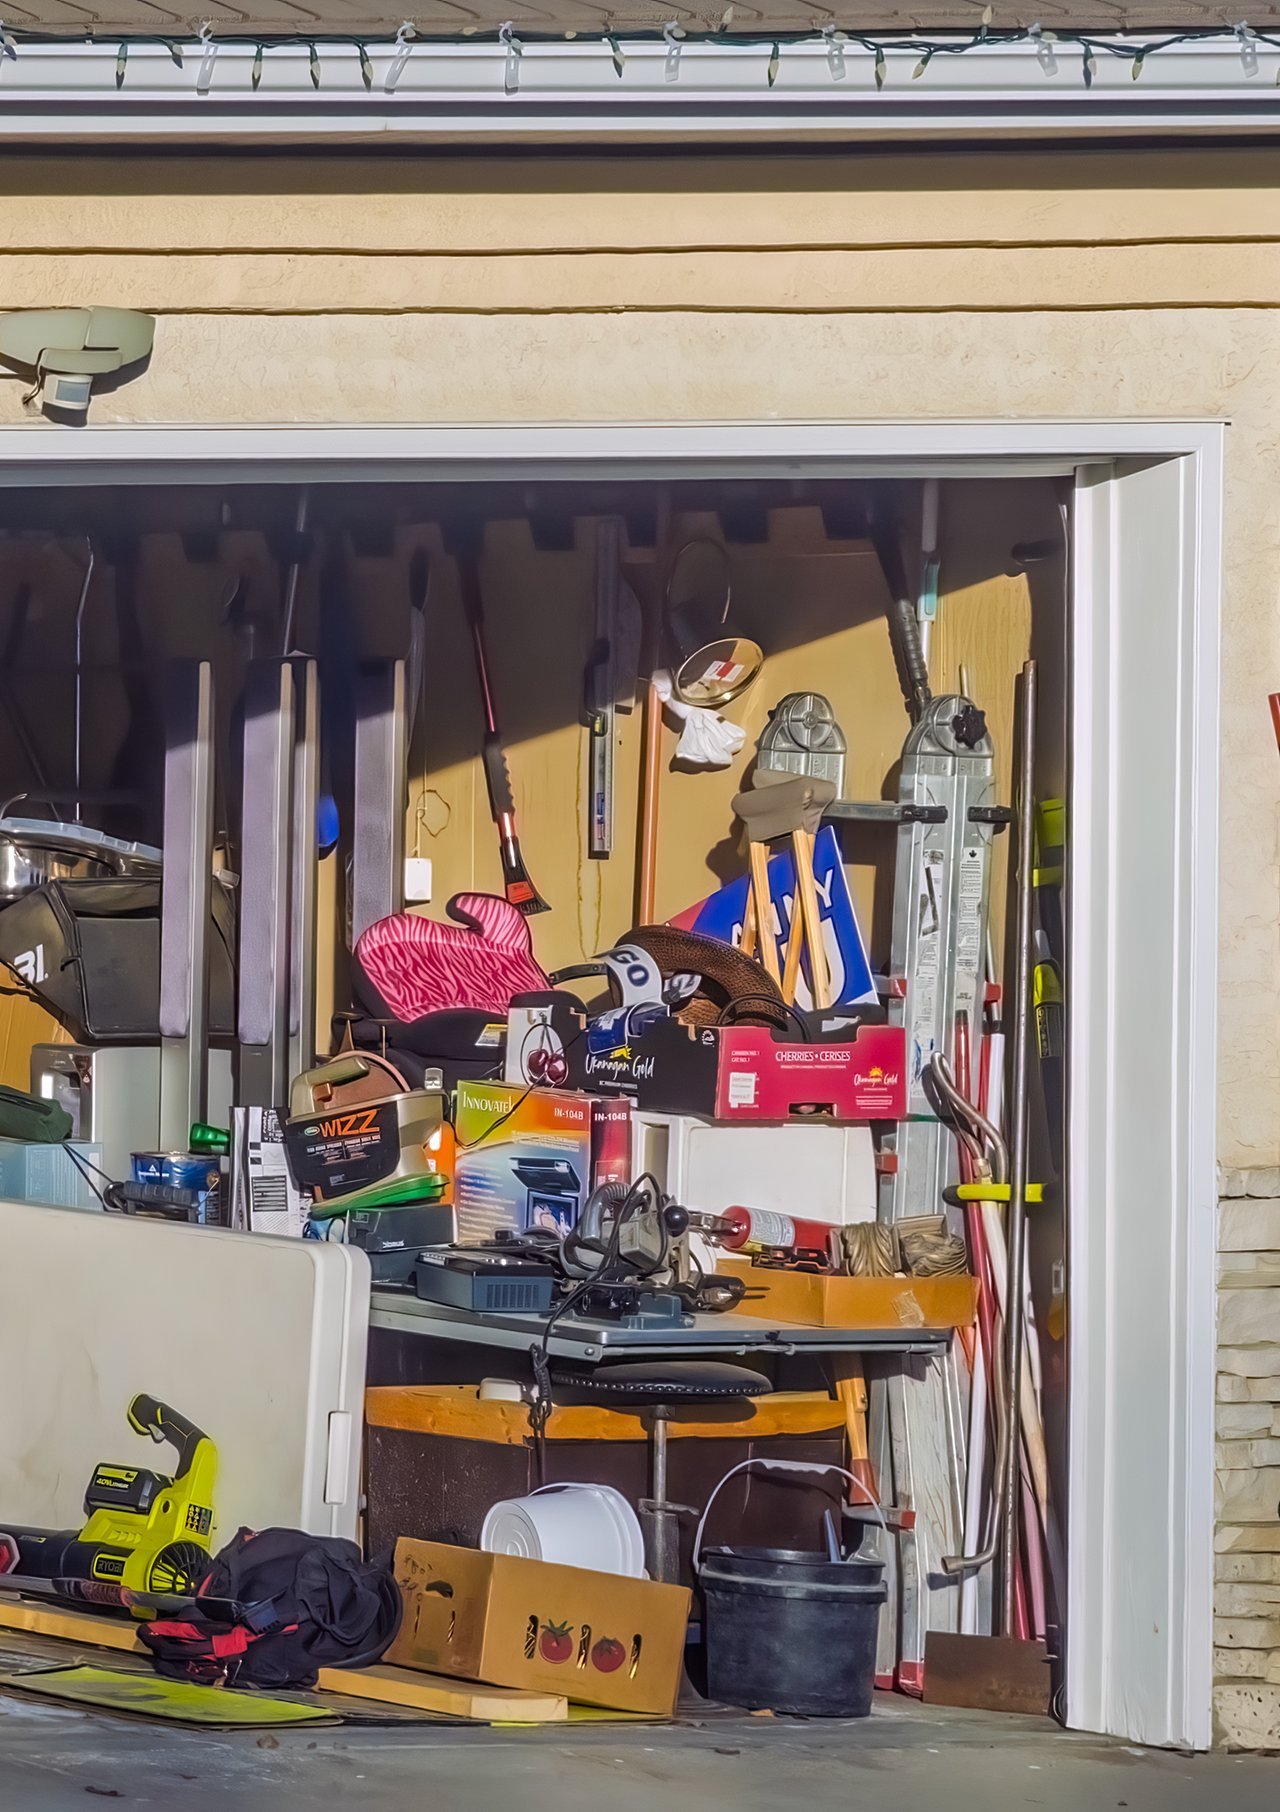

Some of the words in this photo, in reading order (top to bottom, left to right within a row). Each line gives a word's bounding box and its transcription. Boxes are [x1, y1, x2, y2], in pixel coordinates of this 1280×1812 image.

[775, 1051, 814, 1062] CHERRIES
[819, 1051, 851, 1062] CERISES
[632, 1055, 655, 1079] Gold
[883, 1073, 898, 1086] Gold
[554, 1107, 584, 1120] IN-104B
[594, 1112, 627, 1122] IN-104B
[319, 1107, 382, 1138] WIZZ
[97, 1559, 123, 1573] RYOBI
